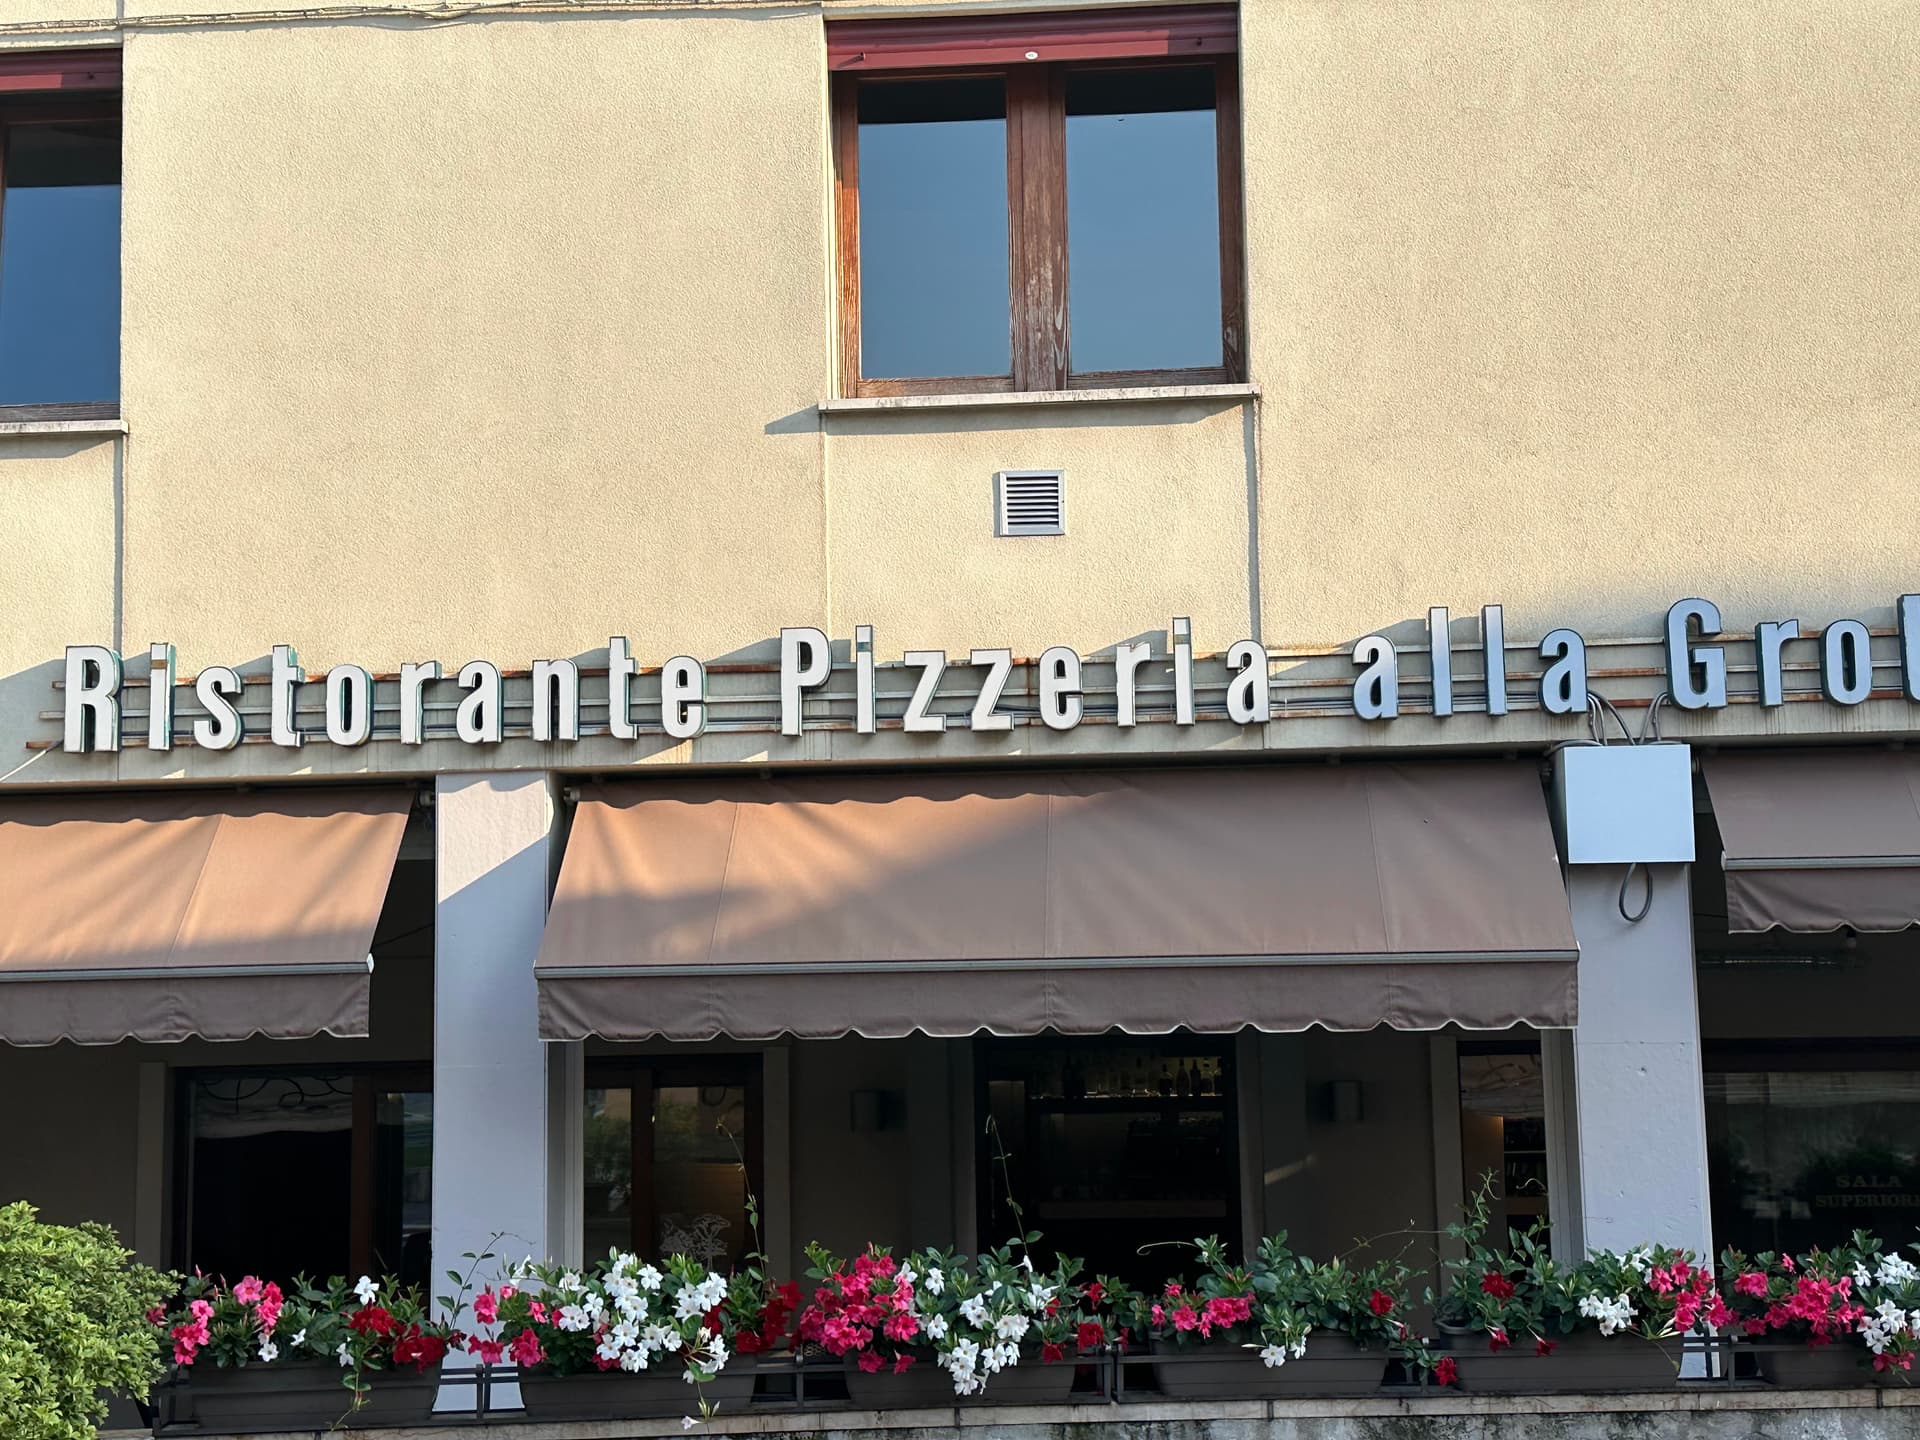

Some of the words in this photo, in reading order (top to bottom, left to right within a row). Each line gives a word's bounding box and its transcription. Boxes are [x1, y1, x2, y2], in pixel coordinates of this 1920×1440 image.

[63, 636, 707, 753] Ristorante
[780, 616, 1271, 736] Pizzeria
[1351, 604, 1591, 720] alla
[1835, 1175, 1904, 1189] SALA
